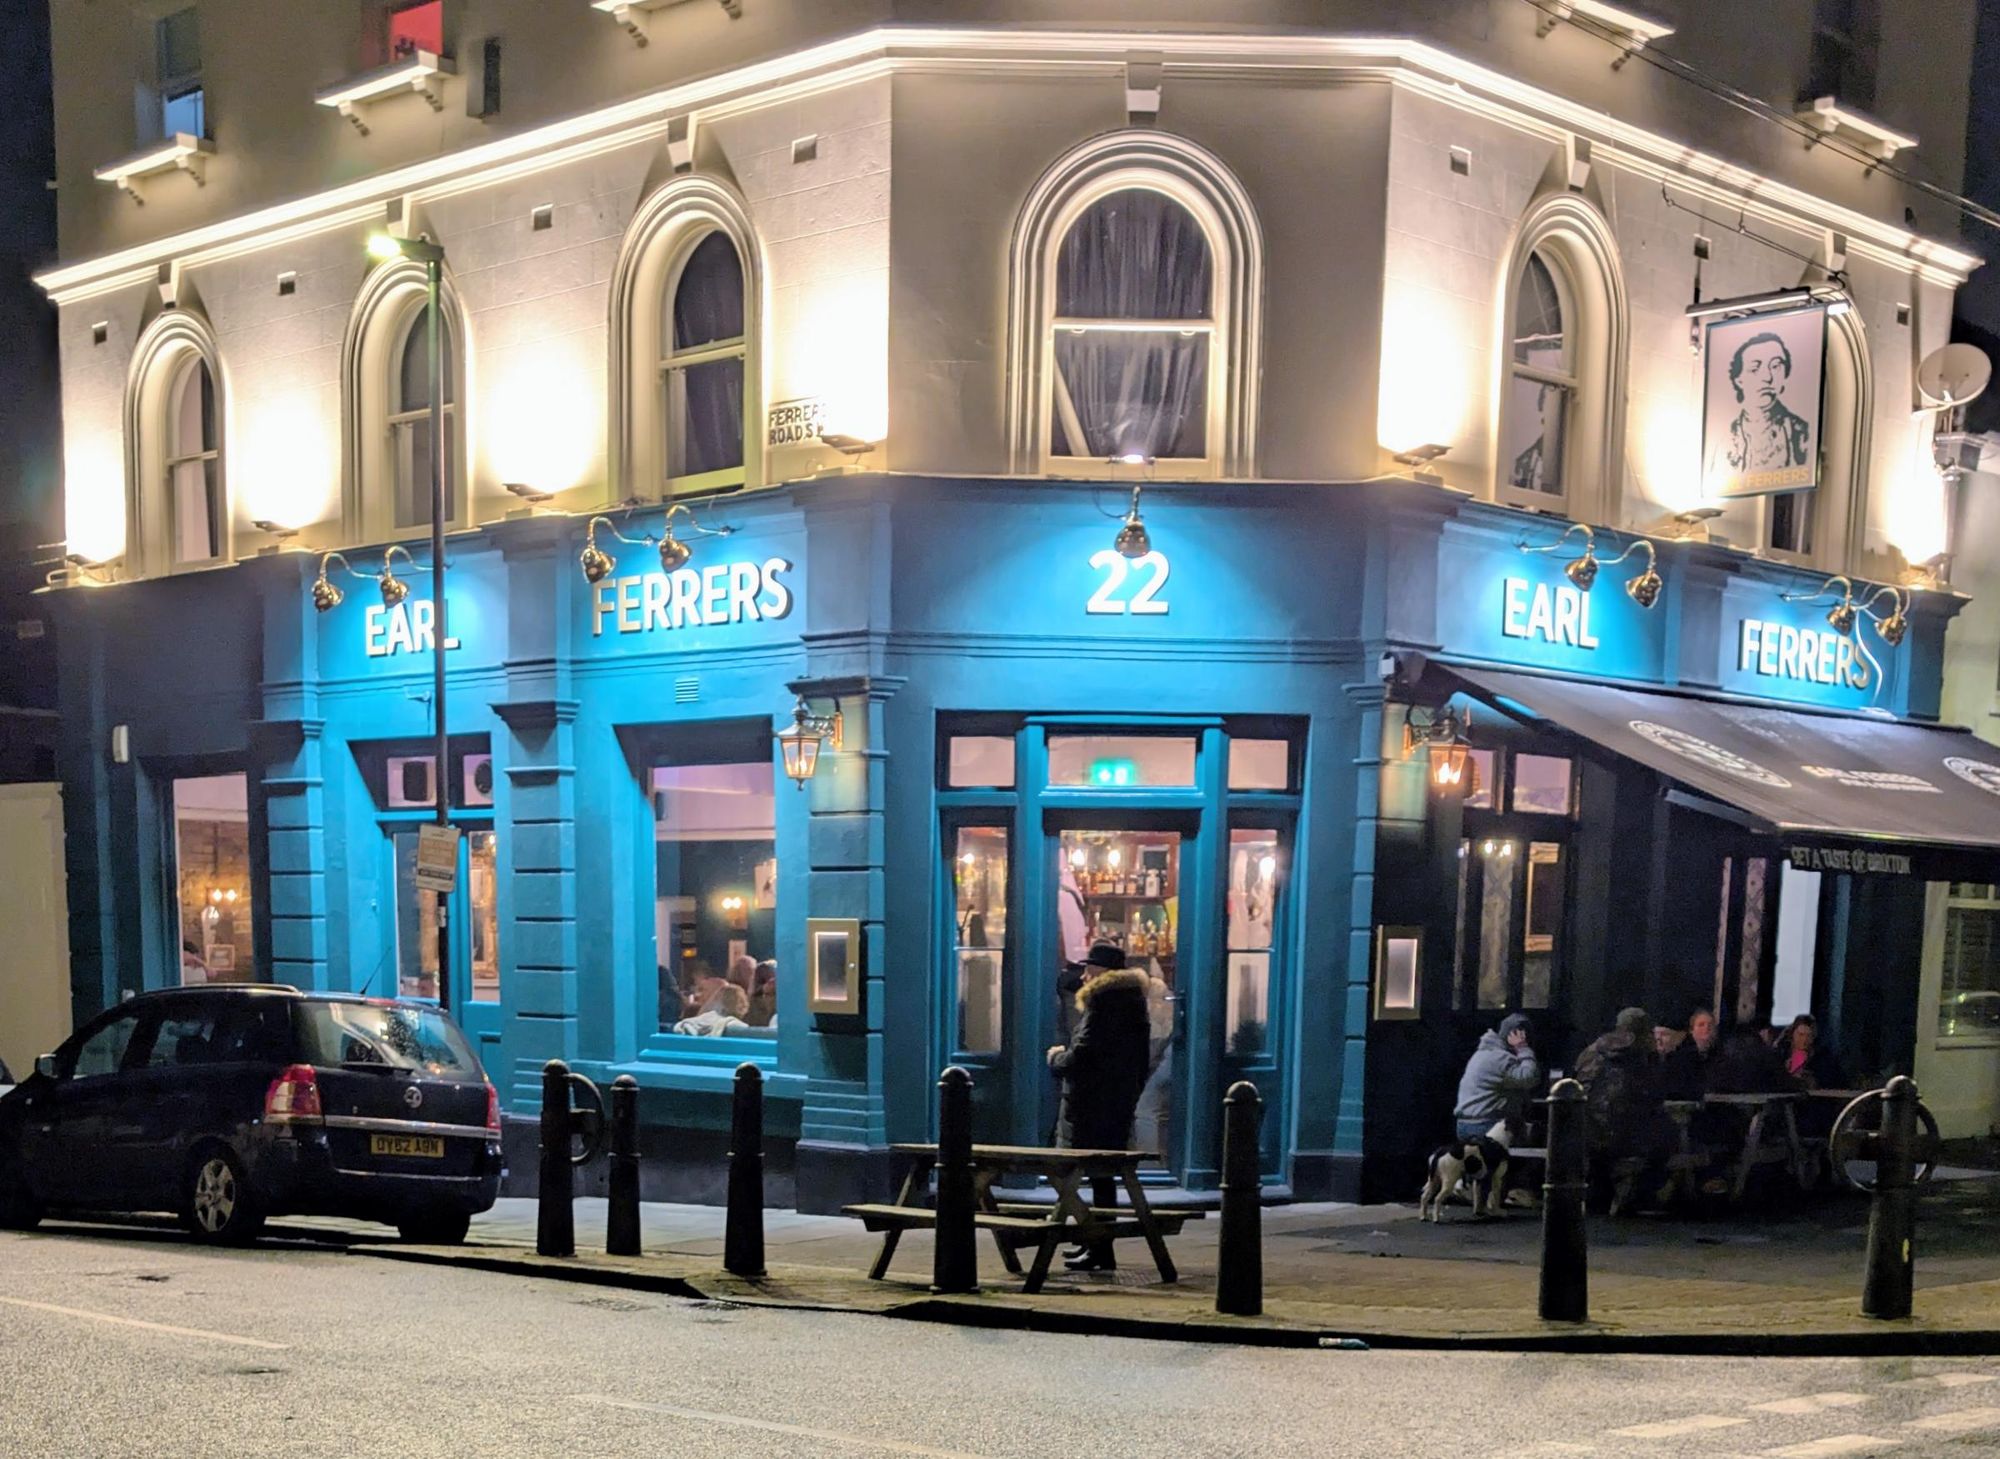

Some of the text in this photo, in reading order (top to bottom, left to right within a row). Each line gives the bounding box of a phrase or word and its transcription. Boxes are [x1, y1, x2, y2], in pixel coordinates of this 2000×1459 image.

[769, 402, 826, 428] FERRER
[769, 425, 803, 446] ROAD
[1745, 467, 1809, 488] FERRERS
[592, 558, 790, 636] FERRERS
[1086, 550, 1169, 615] 22
[1503, 576, 1599, 650] EARL
[1739, 618, 1871, 688] FERRERS
